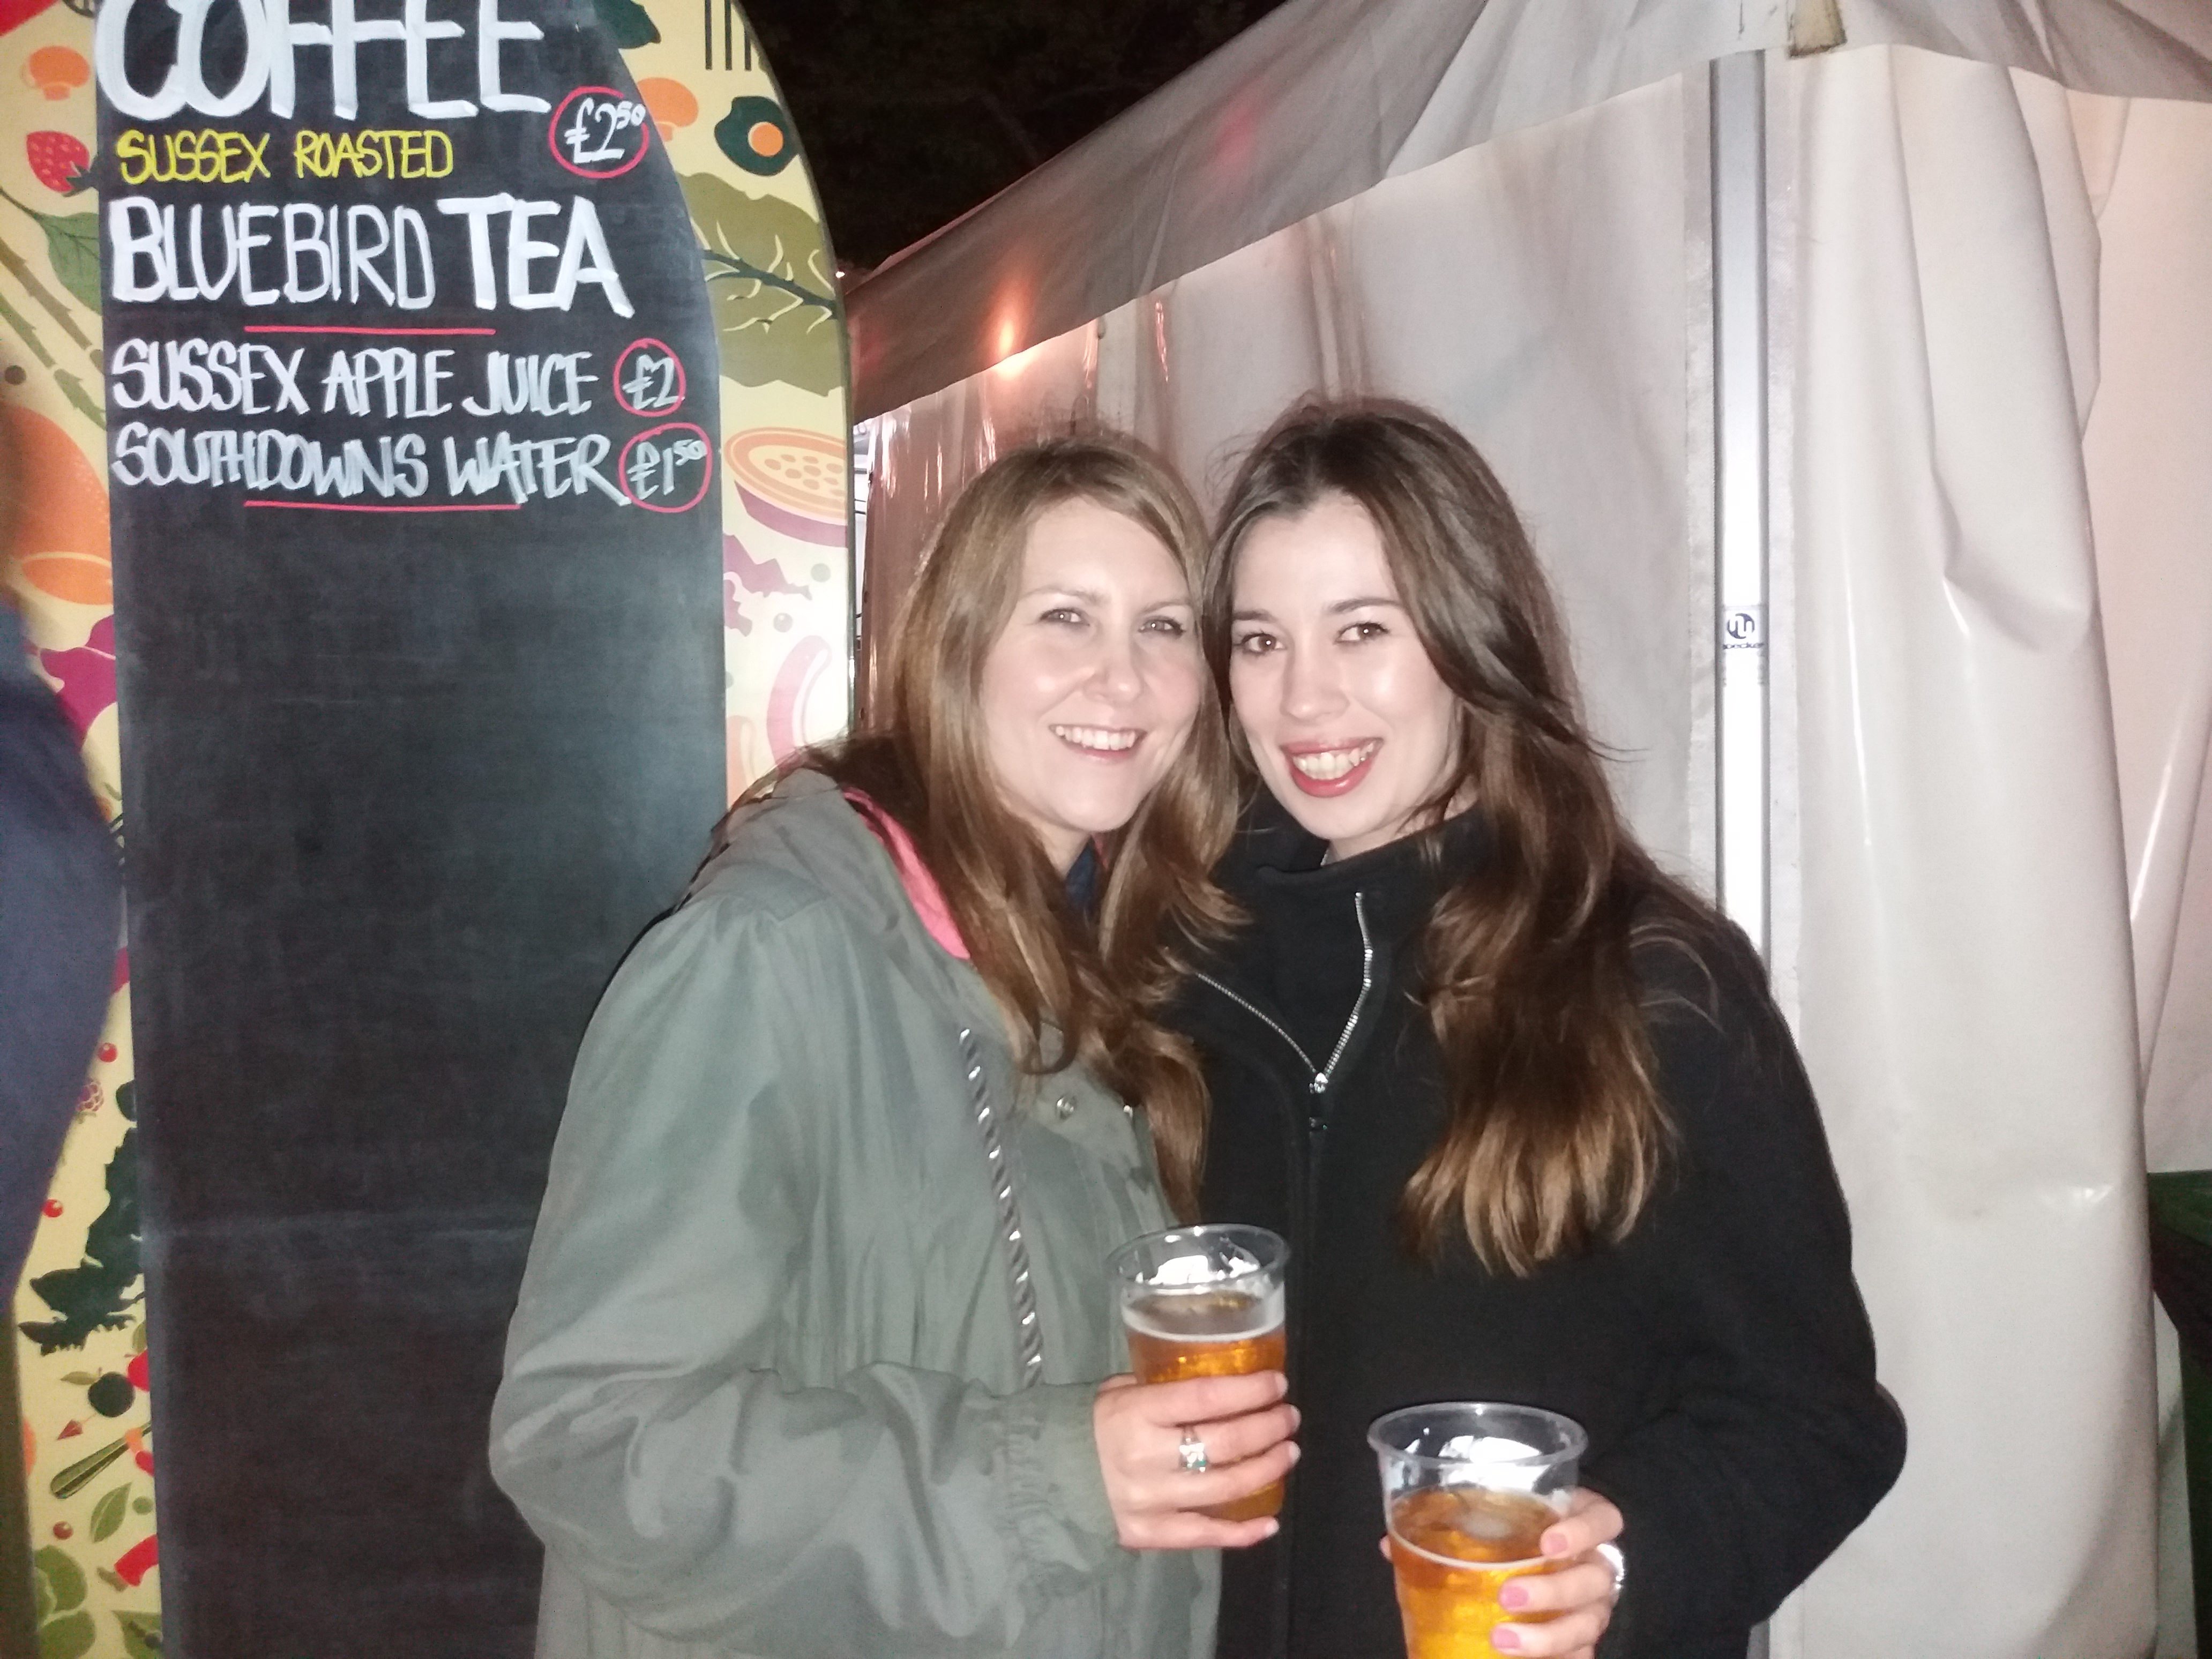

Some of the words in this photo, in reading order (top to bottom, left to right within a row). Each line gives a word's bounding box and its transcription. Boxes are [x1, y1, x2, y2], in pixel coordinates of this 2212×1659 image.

[94, 0, 552, 121] COFFEE
[116, 129, 271, 184] SUSSEX
[294, 129, 454, 180] ROASTED
[109, 196, 436, 310] BLUEBIRD
[437, 192, 634, 318] TEA
[110, 338, 310, 414] SUSSEX
[322, 347, 455, 419] APPLE
[461, 350, 599, 416] JUICE
[622, 354, 685, 410] £2
[110, 422, 428, 499] SOUTHDOWNS
[443, 431, 632, 507] WATER
